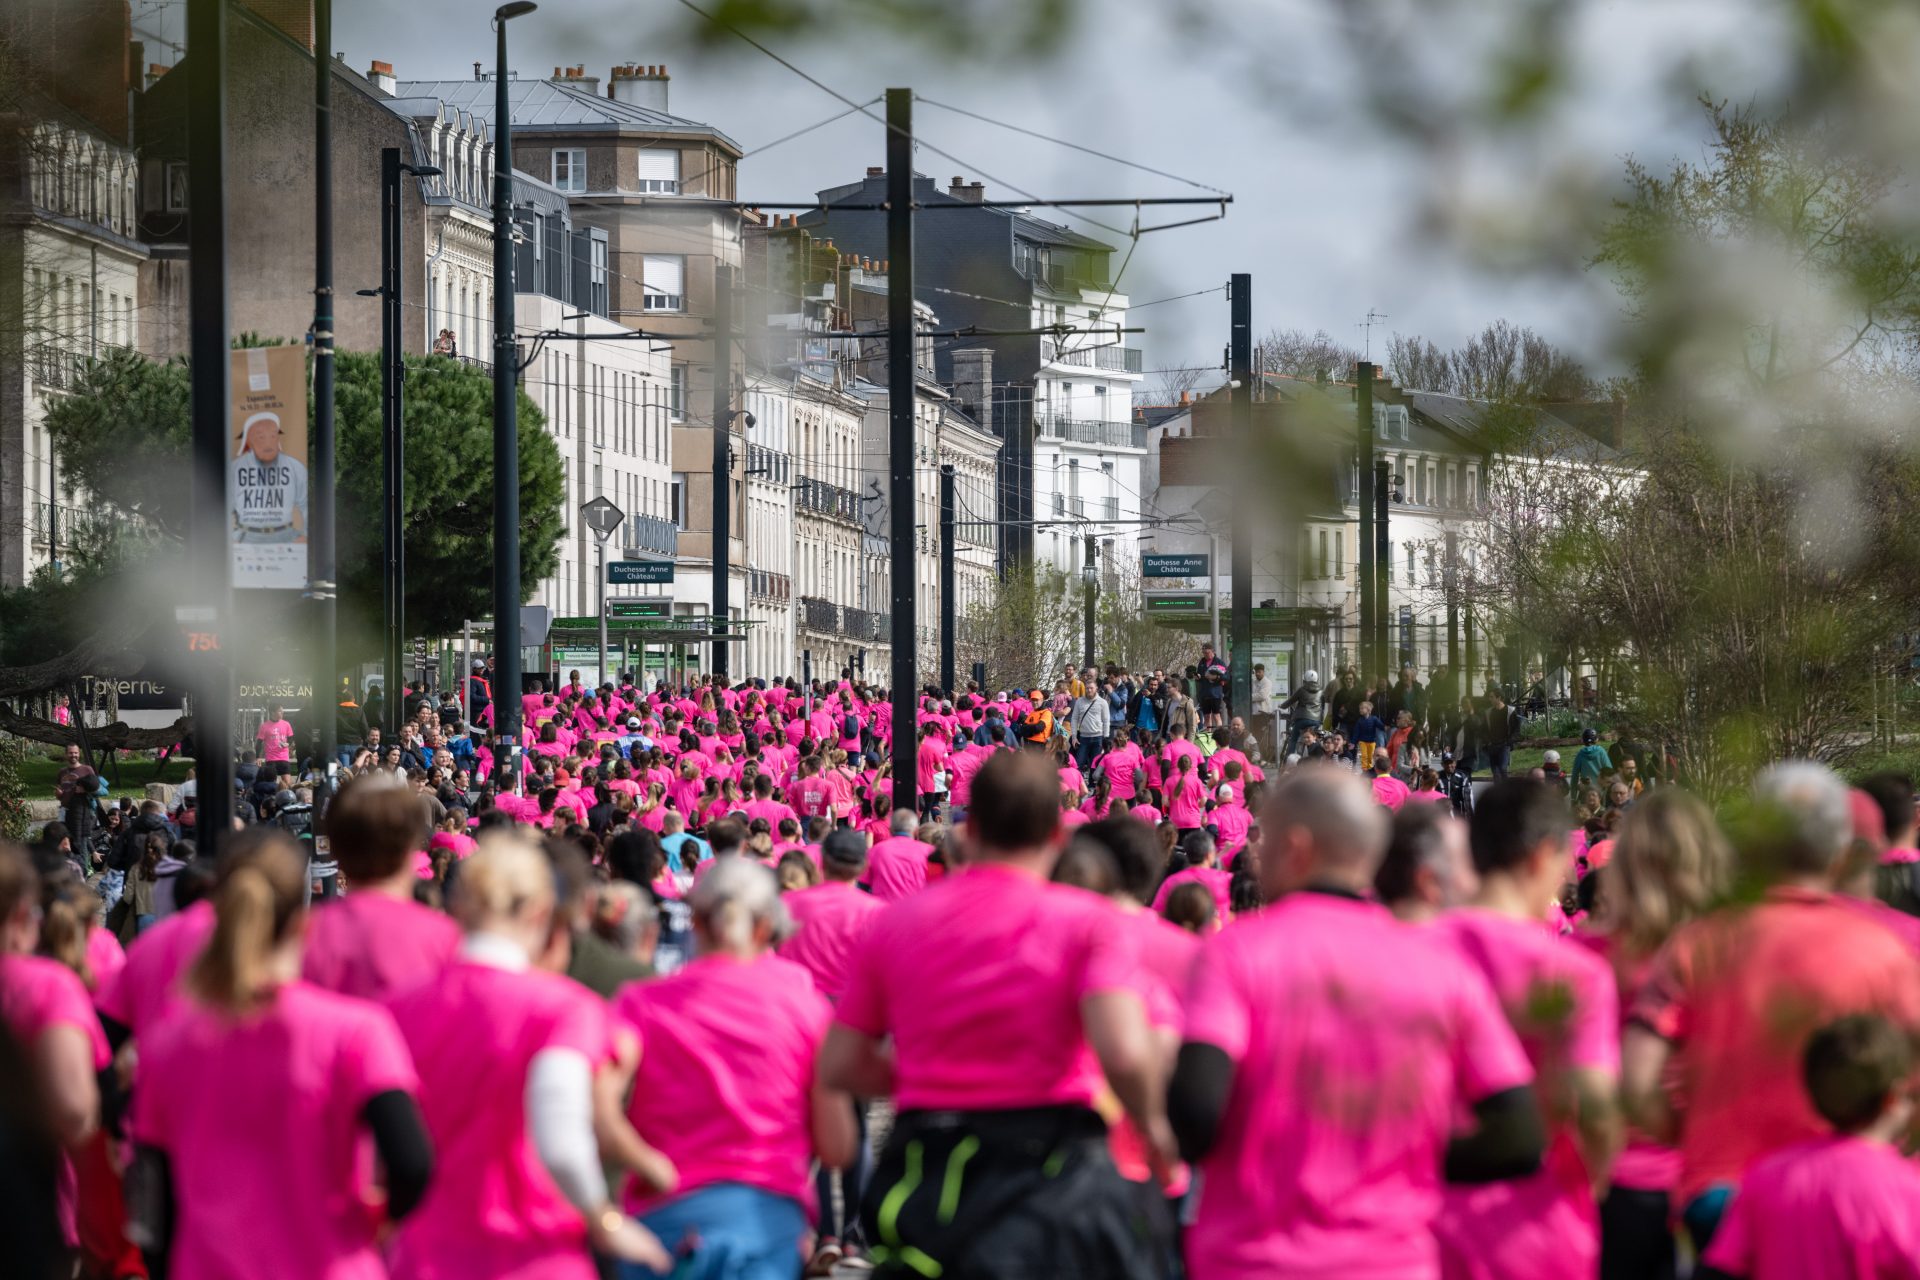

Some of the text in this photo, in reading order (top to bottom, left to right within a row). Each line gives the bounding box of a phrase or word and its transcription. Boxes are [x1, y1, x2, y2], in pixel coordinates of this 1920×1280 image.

[238, 467, 290, 486] GENGIS
[243, 488, 284, 509] KHAN
[81, 675, 165, 695] Taverne
